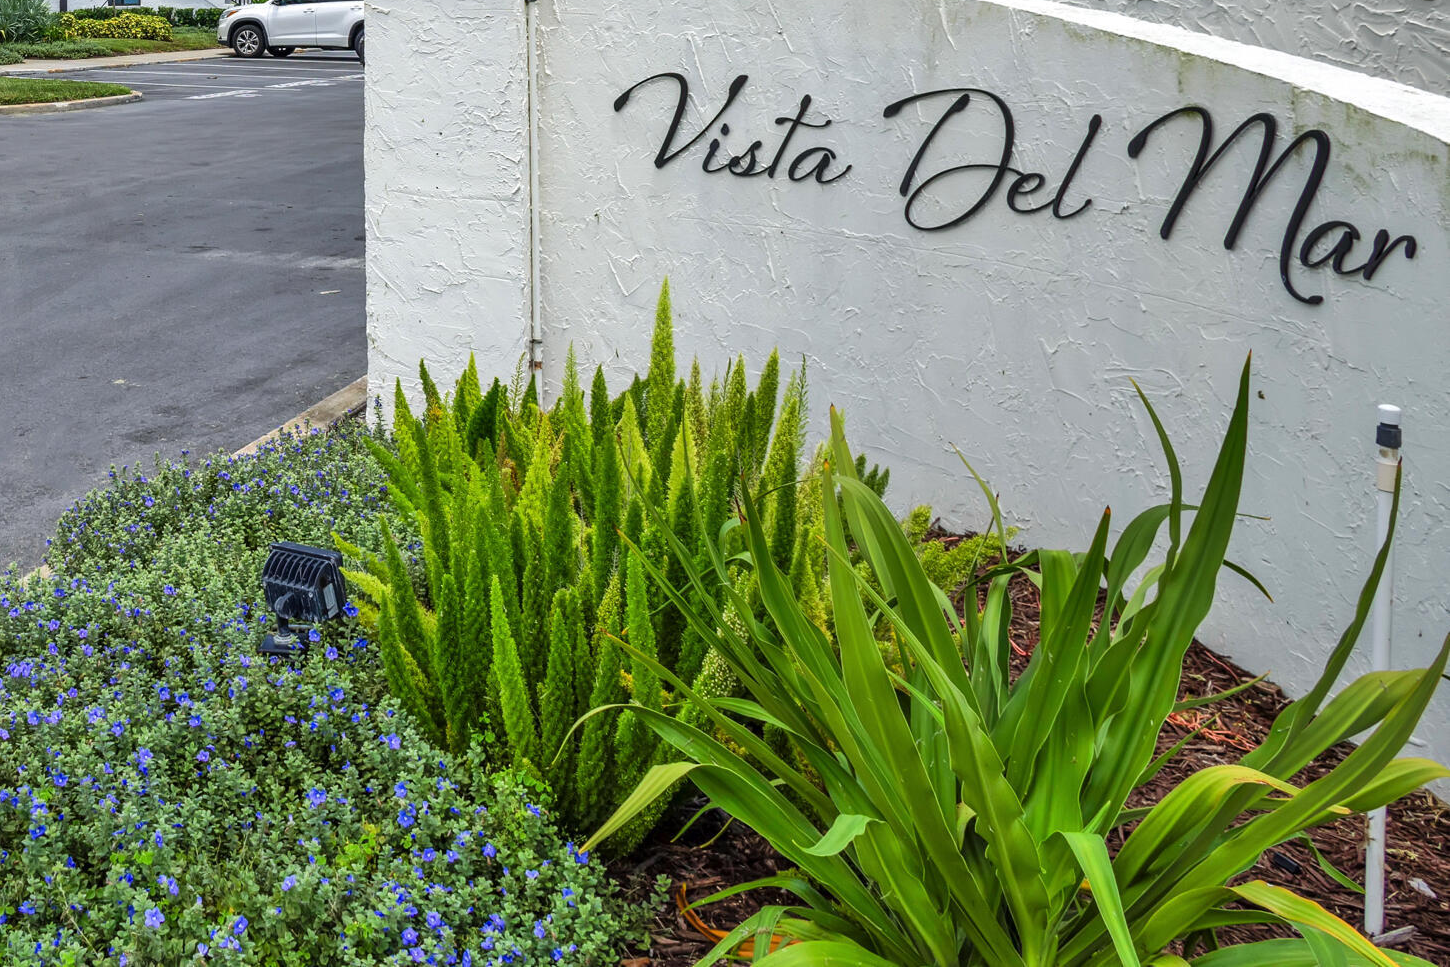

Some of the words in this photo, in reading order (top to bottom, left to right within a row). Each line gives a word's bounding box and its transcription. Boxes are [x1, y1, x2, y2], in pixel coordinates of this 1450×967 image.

[613, 72, 852, 184] Vista
[883, 88, 1103, 231] Del
[1127, 105, 1417, 306] Mar
